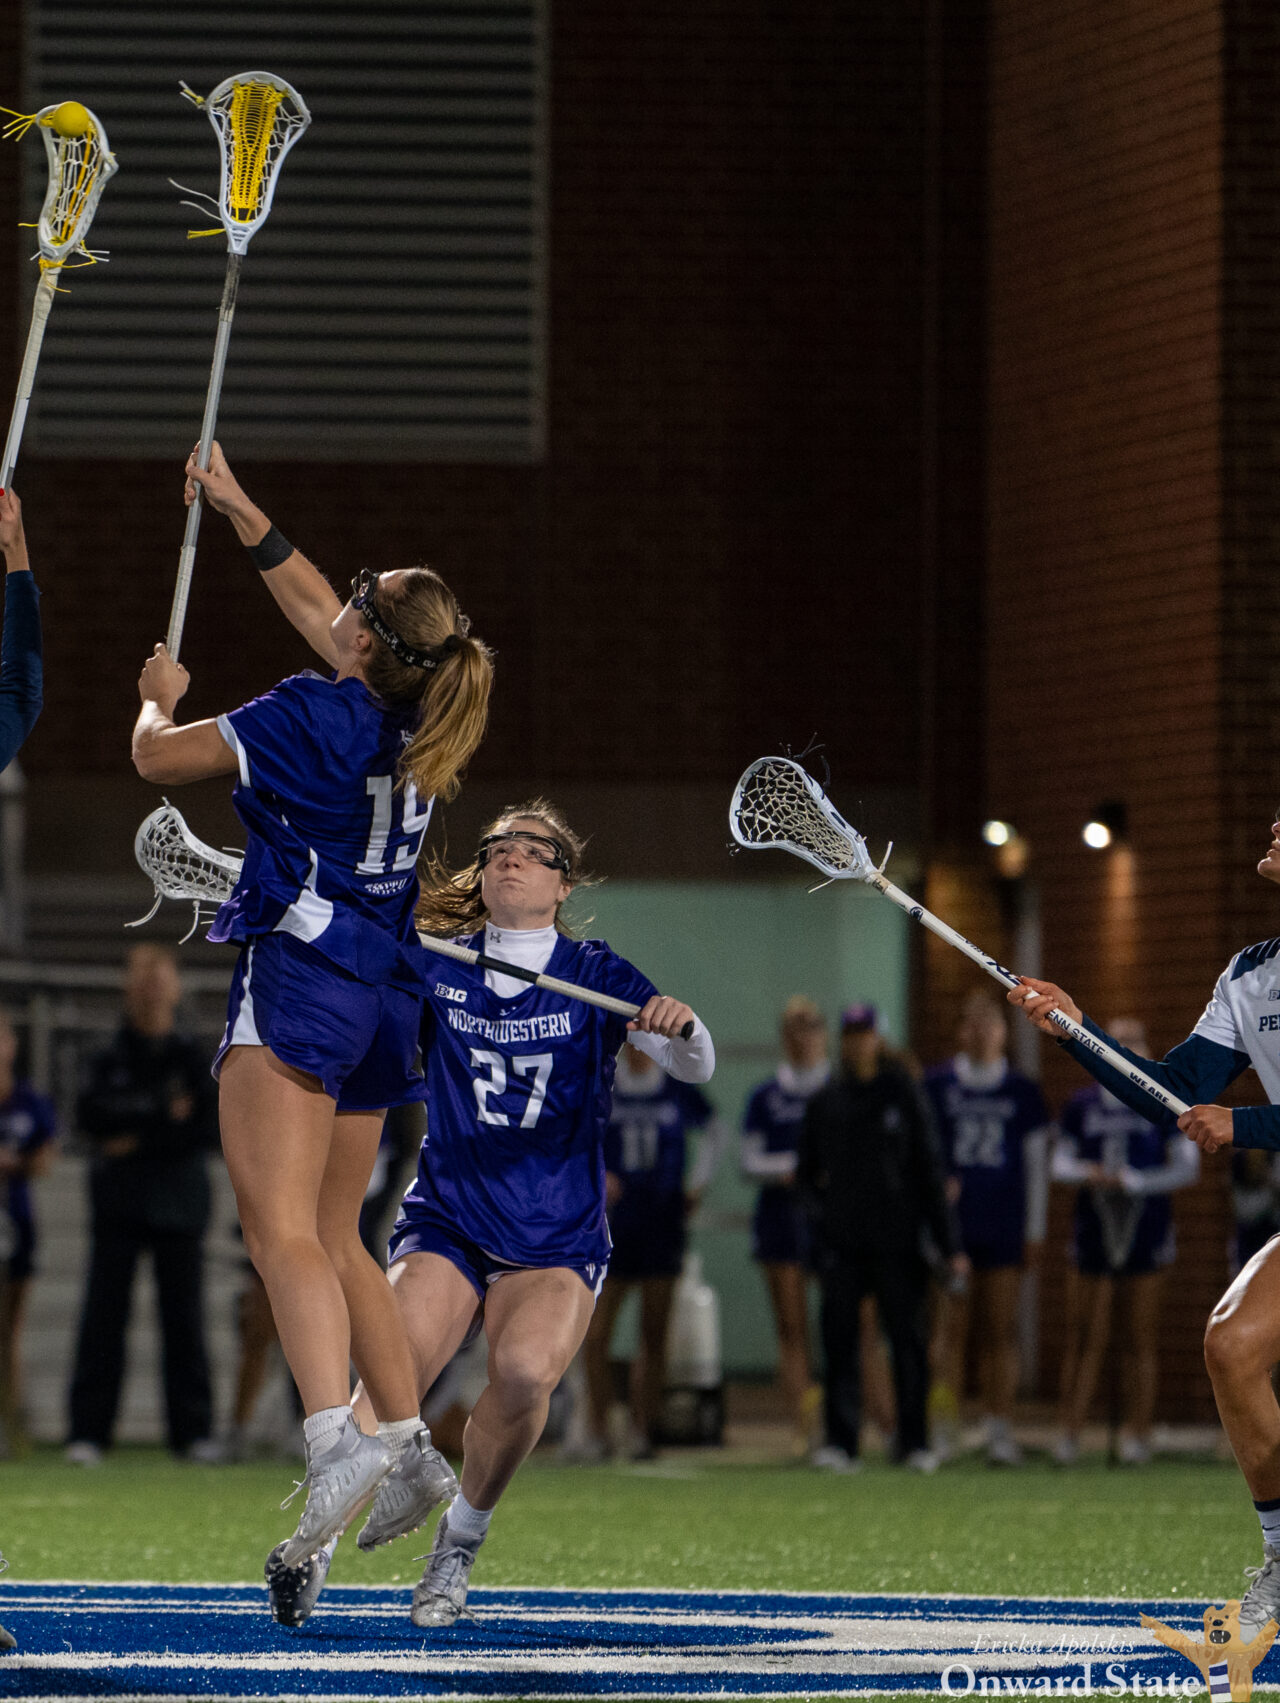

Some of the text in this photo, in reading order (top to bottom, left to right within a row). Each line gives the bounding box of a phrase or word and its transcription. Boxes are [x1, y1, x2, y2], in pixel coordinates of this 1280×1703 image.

[447, 1007, 572, 1044] NORTHWESTERN
[1045, 1009, 1106, 1056] ENN STATE
[1258, 1014, 1280, 1033] PE
[469, 1047, 554, 1129] 27
[1129, 1071, 1170, 1105] WE ARE
